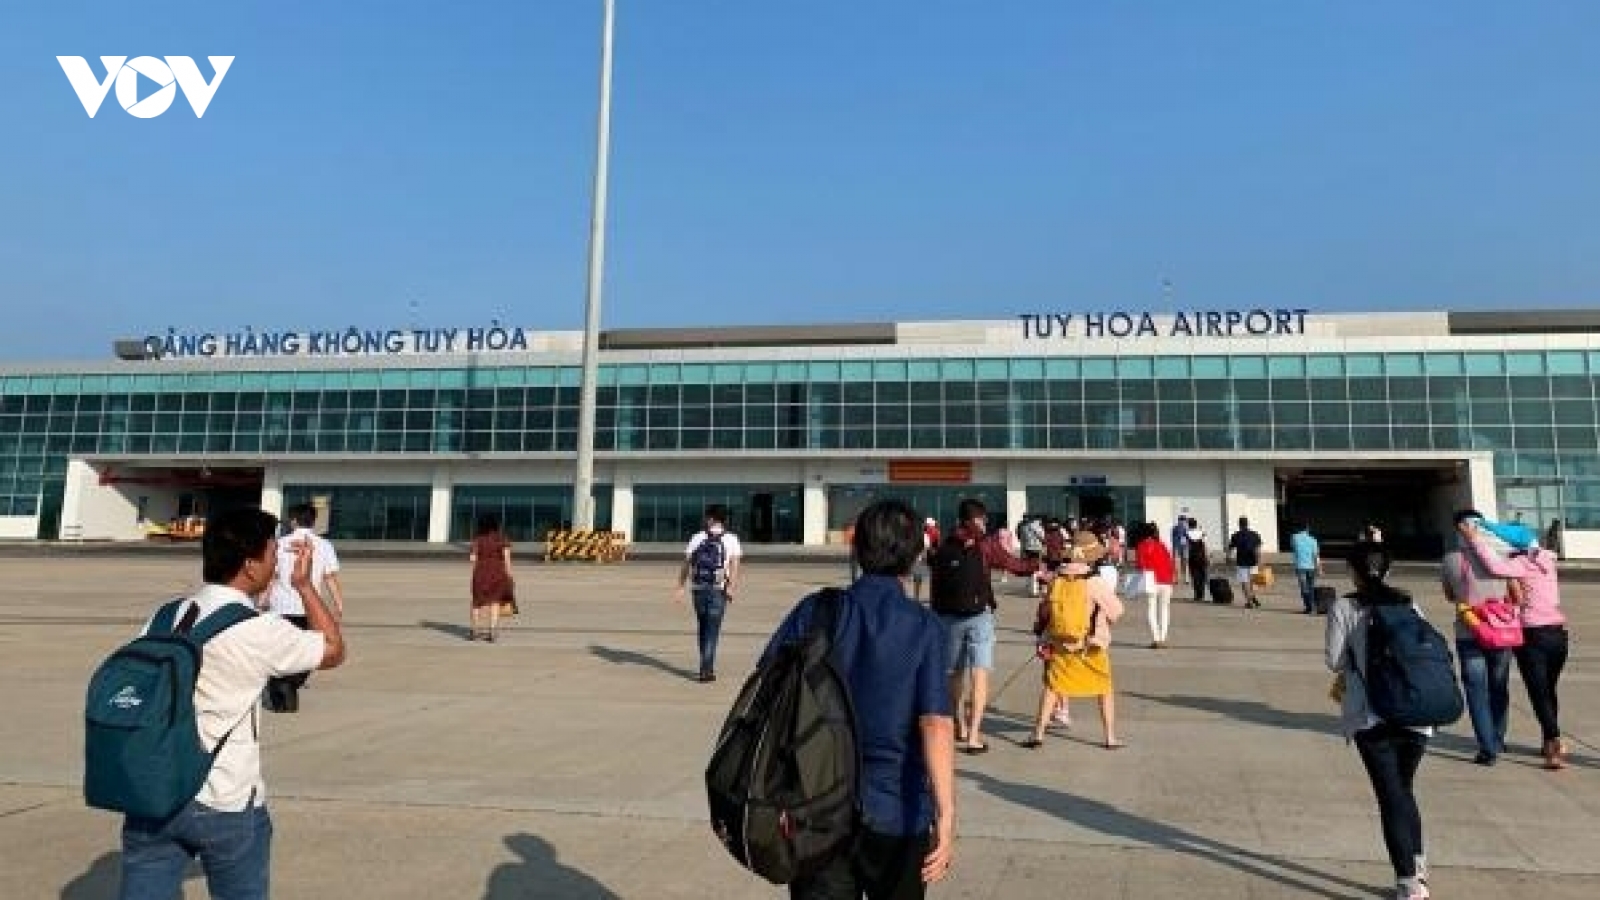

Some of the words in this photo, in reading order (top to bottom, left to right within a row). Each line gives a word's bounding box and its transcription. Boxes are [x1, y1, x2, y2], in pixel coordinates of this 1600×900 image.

[226, 325, 300, 355] HÀNG
[309, 325, 404, 353] KHÔNG
[413, 327, 457, 352] TUY
[467, 319, 527, 350] HÒA
[1019, 313, 1071, 338] TUY
[1085, 311, 1157, 337] HOA
[1170, 308, 1309, 336] AIRPORT
